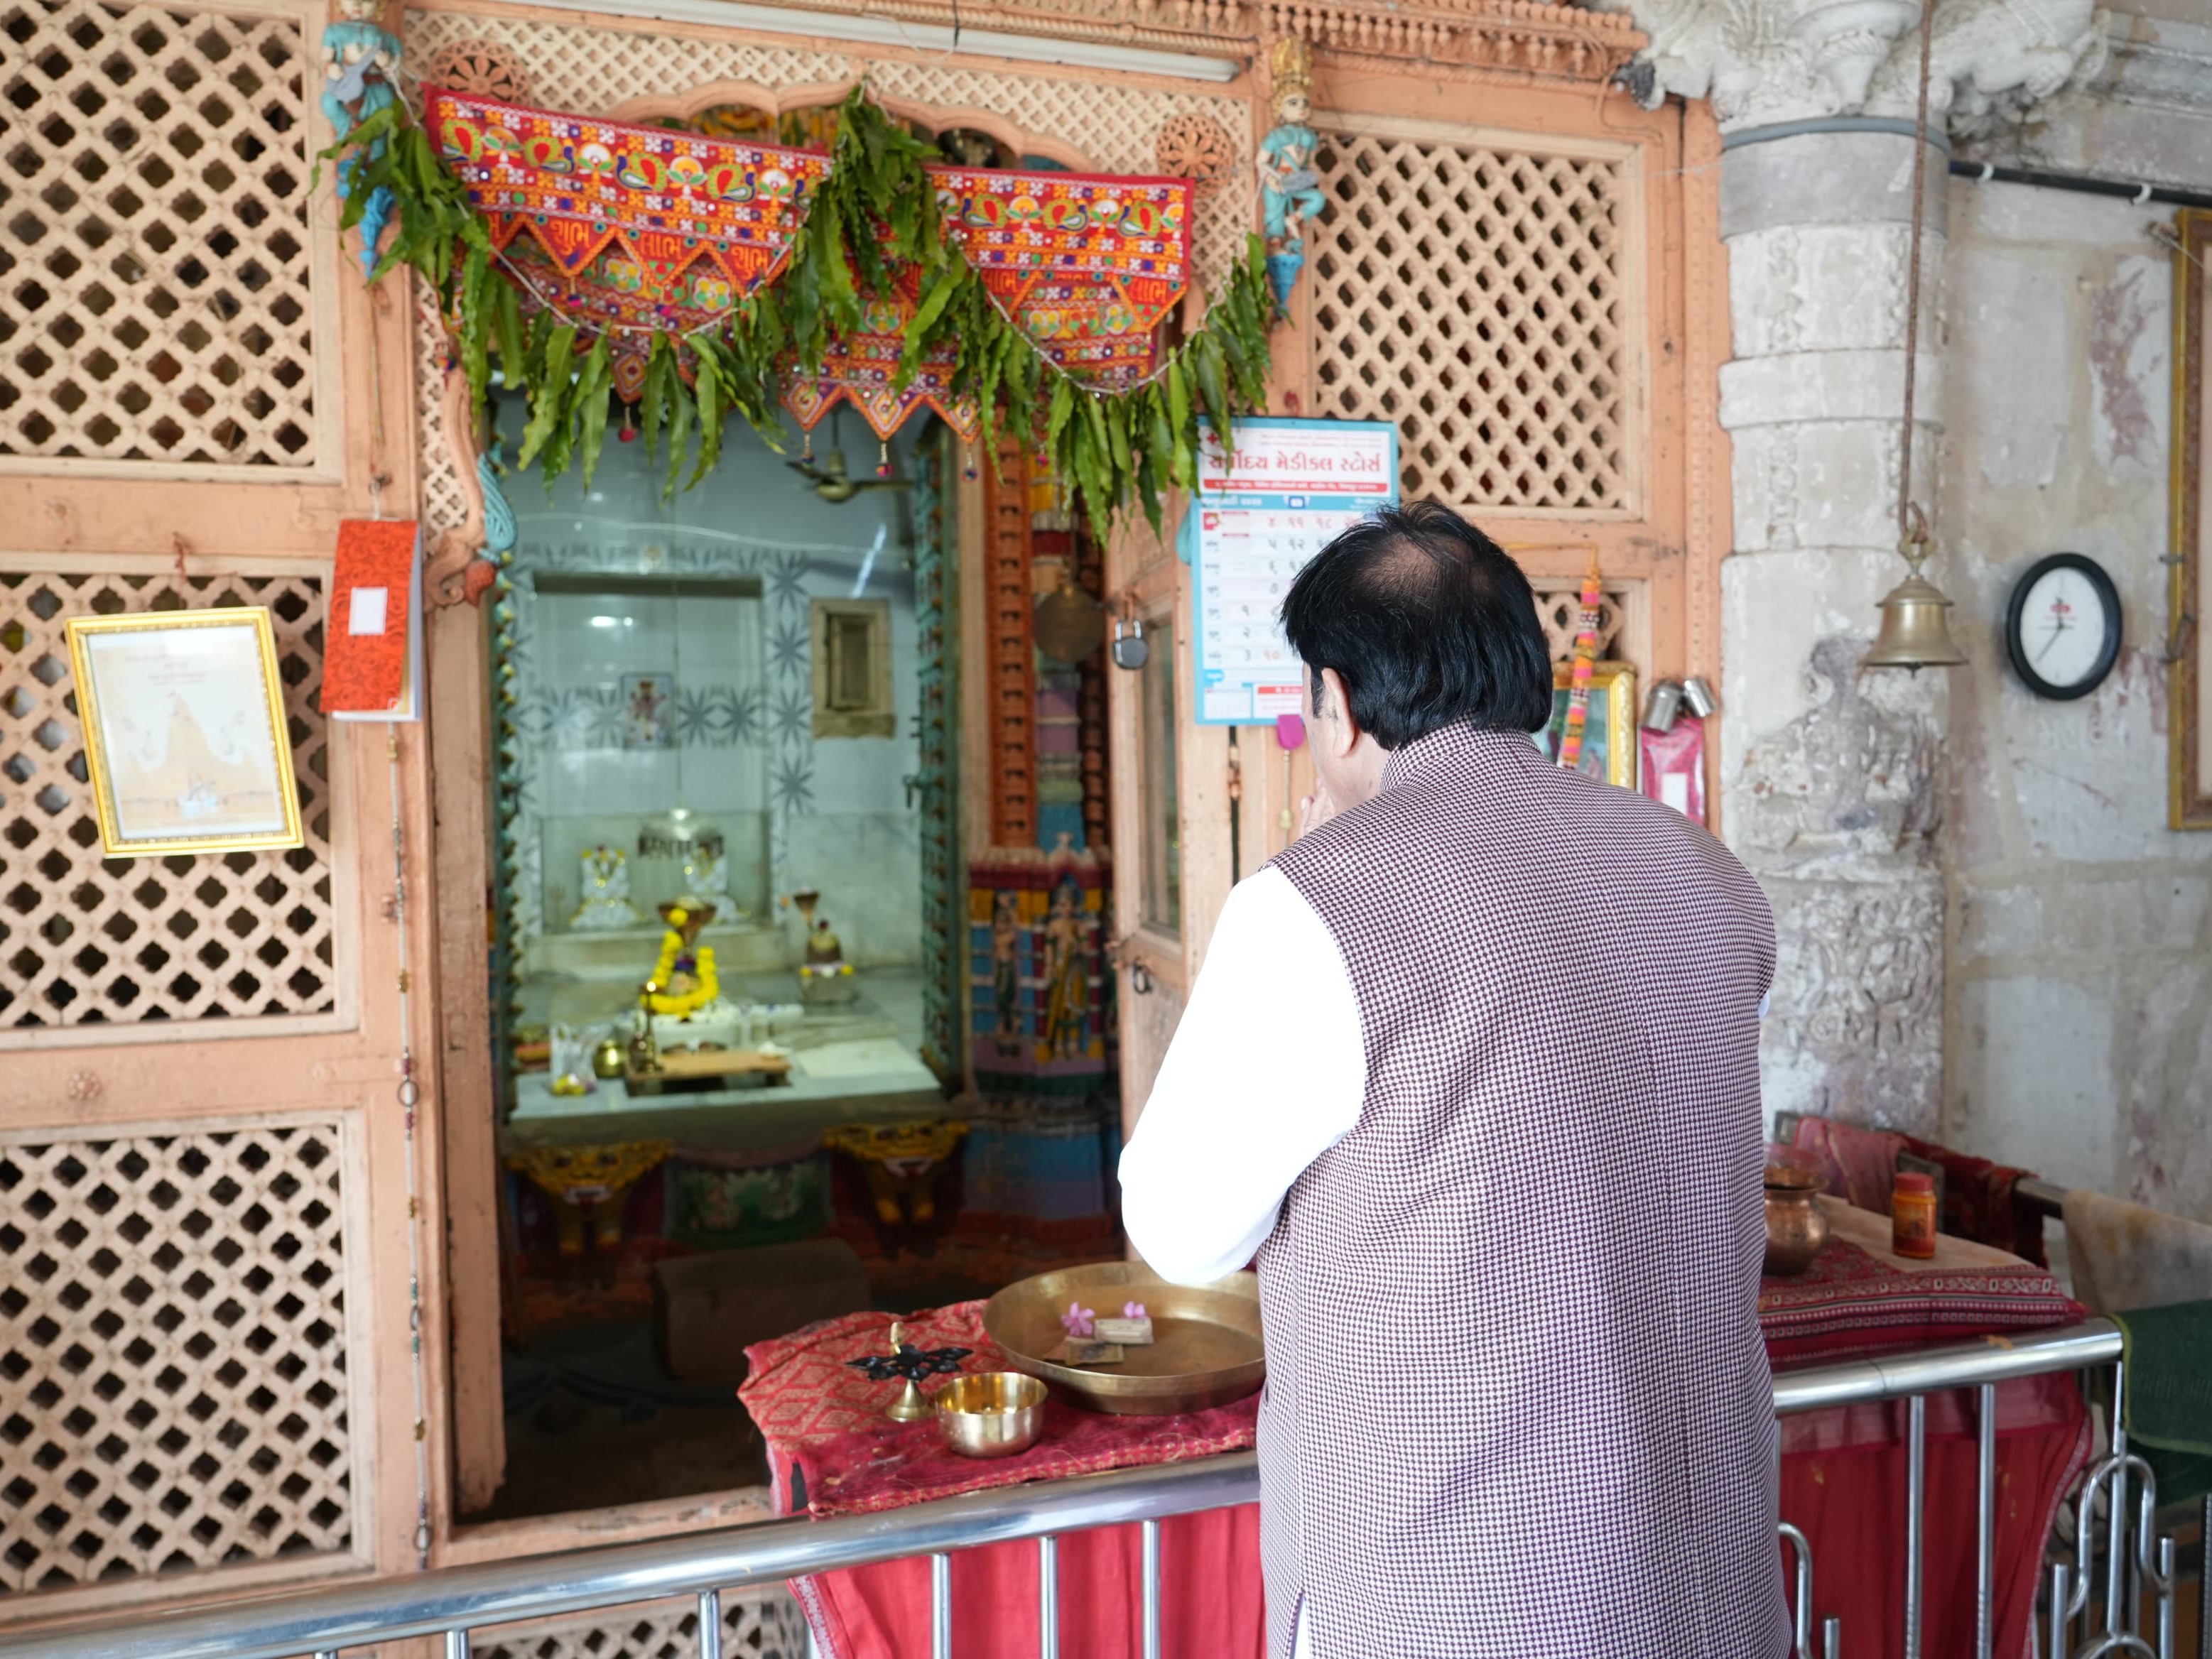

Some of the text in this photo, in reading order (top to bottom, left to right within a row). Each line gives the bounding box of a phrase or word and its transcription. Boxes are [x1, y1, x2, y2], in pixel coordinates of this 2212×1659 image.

[549, 219, 591, 256] શુભ
[641, 232, 682, 259] લાભ
[1276, 450, 1333, 471] મેડીકલ
[1340, 450, 1382, 472] સ્ટોર્સ
